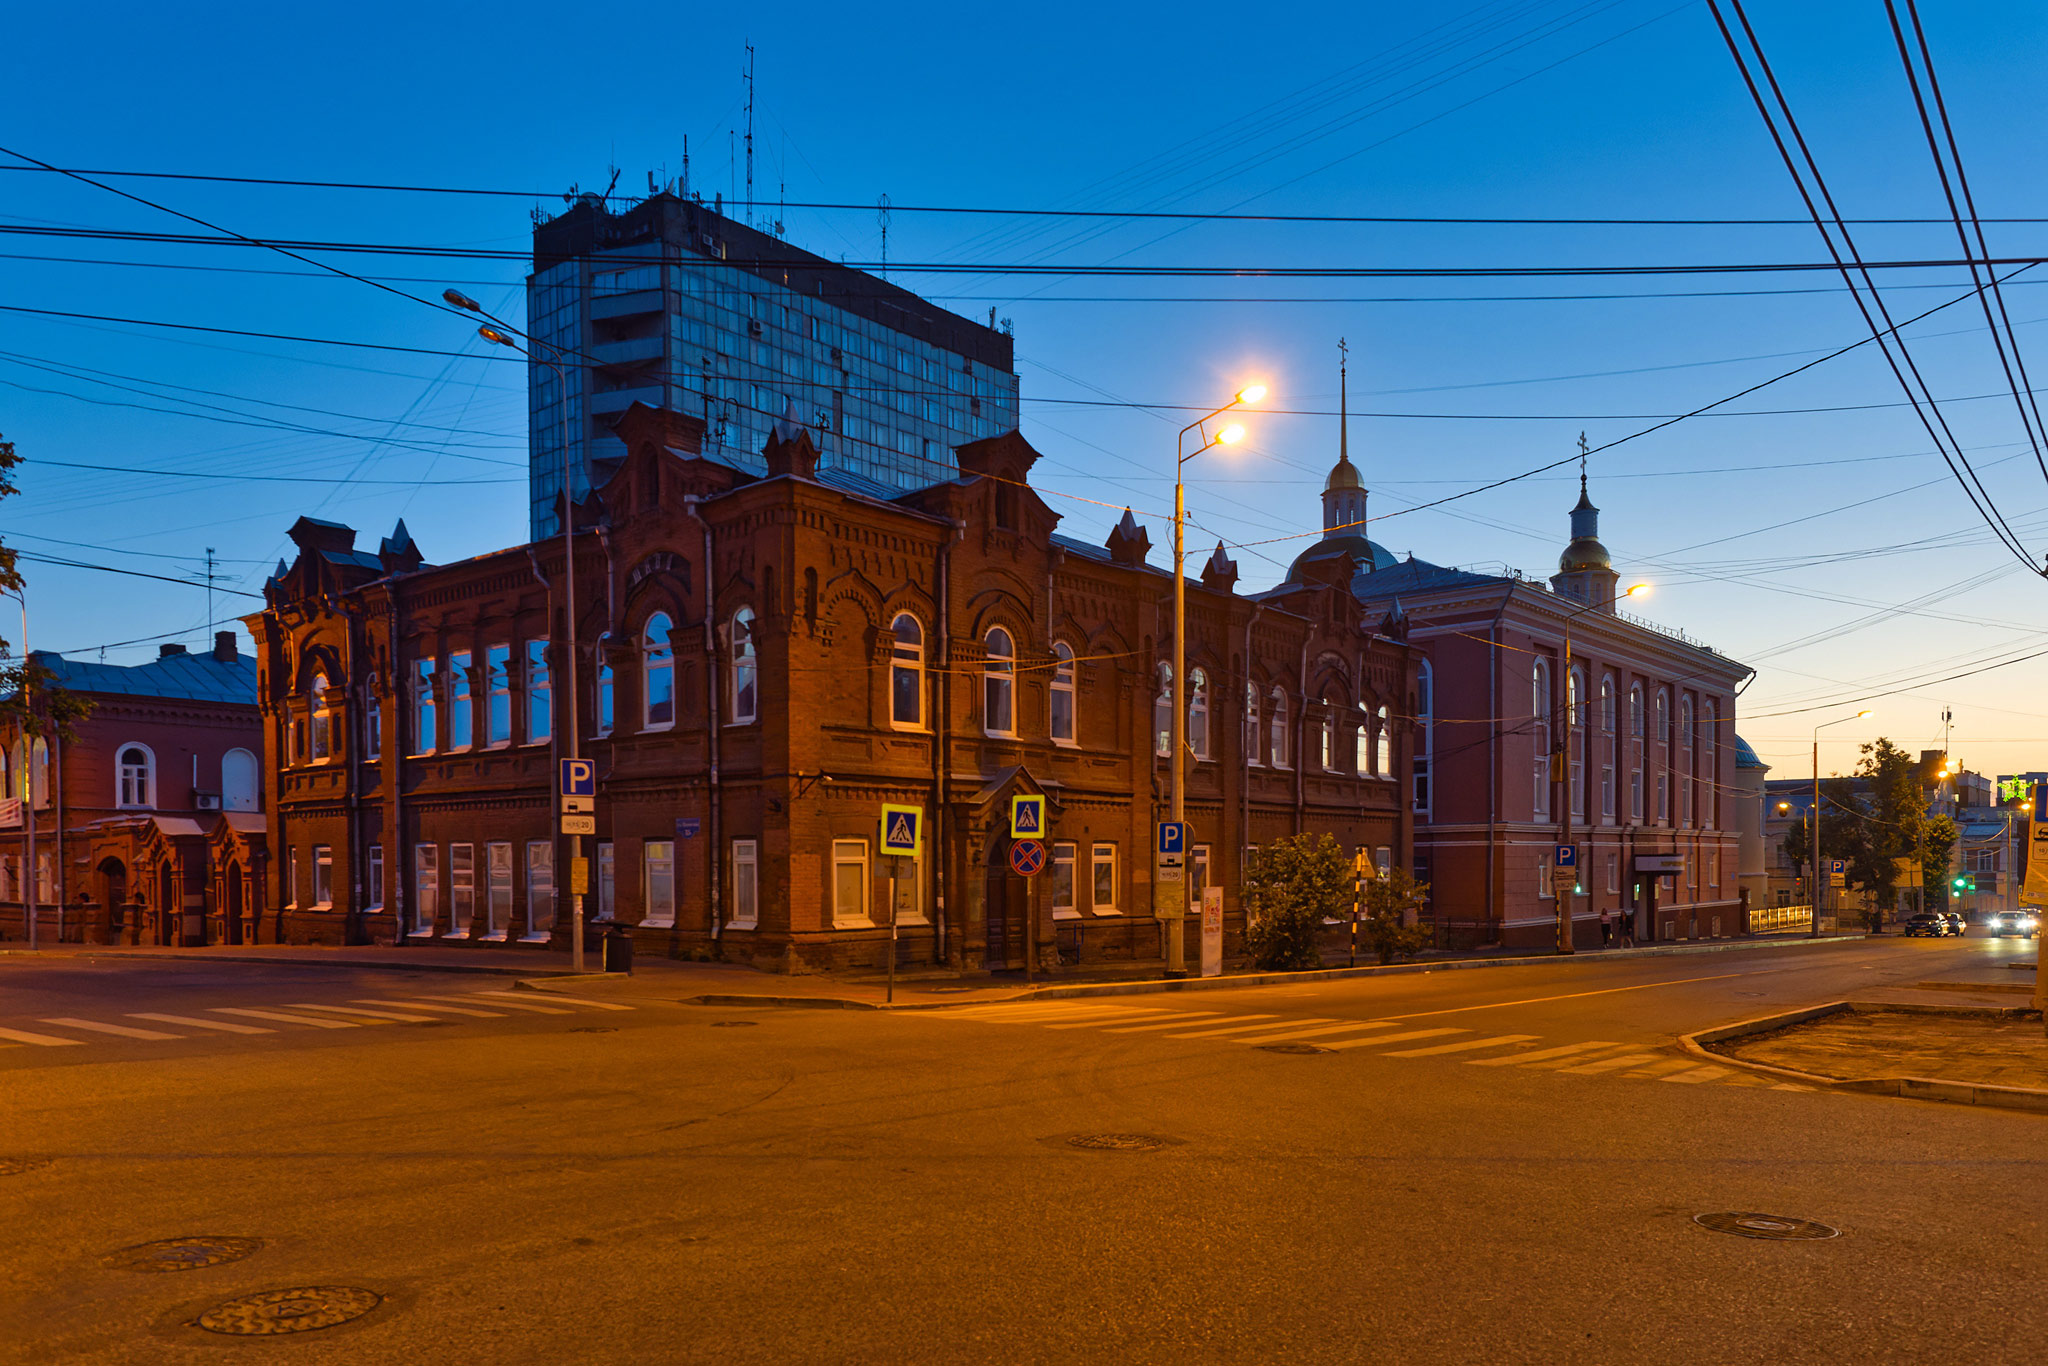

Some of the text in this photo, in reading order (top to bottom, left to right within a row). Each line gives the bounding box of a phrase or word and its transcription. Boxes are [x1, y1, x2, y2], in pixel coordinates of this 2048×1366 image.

[569, 762, 591, 793] P
[1165, 825, 1179, 849] P
[1560, 847, 1571, 864] P
[1833, 861, 1842, 872] P
